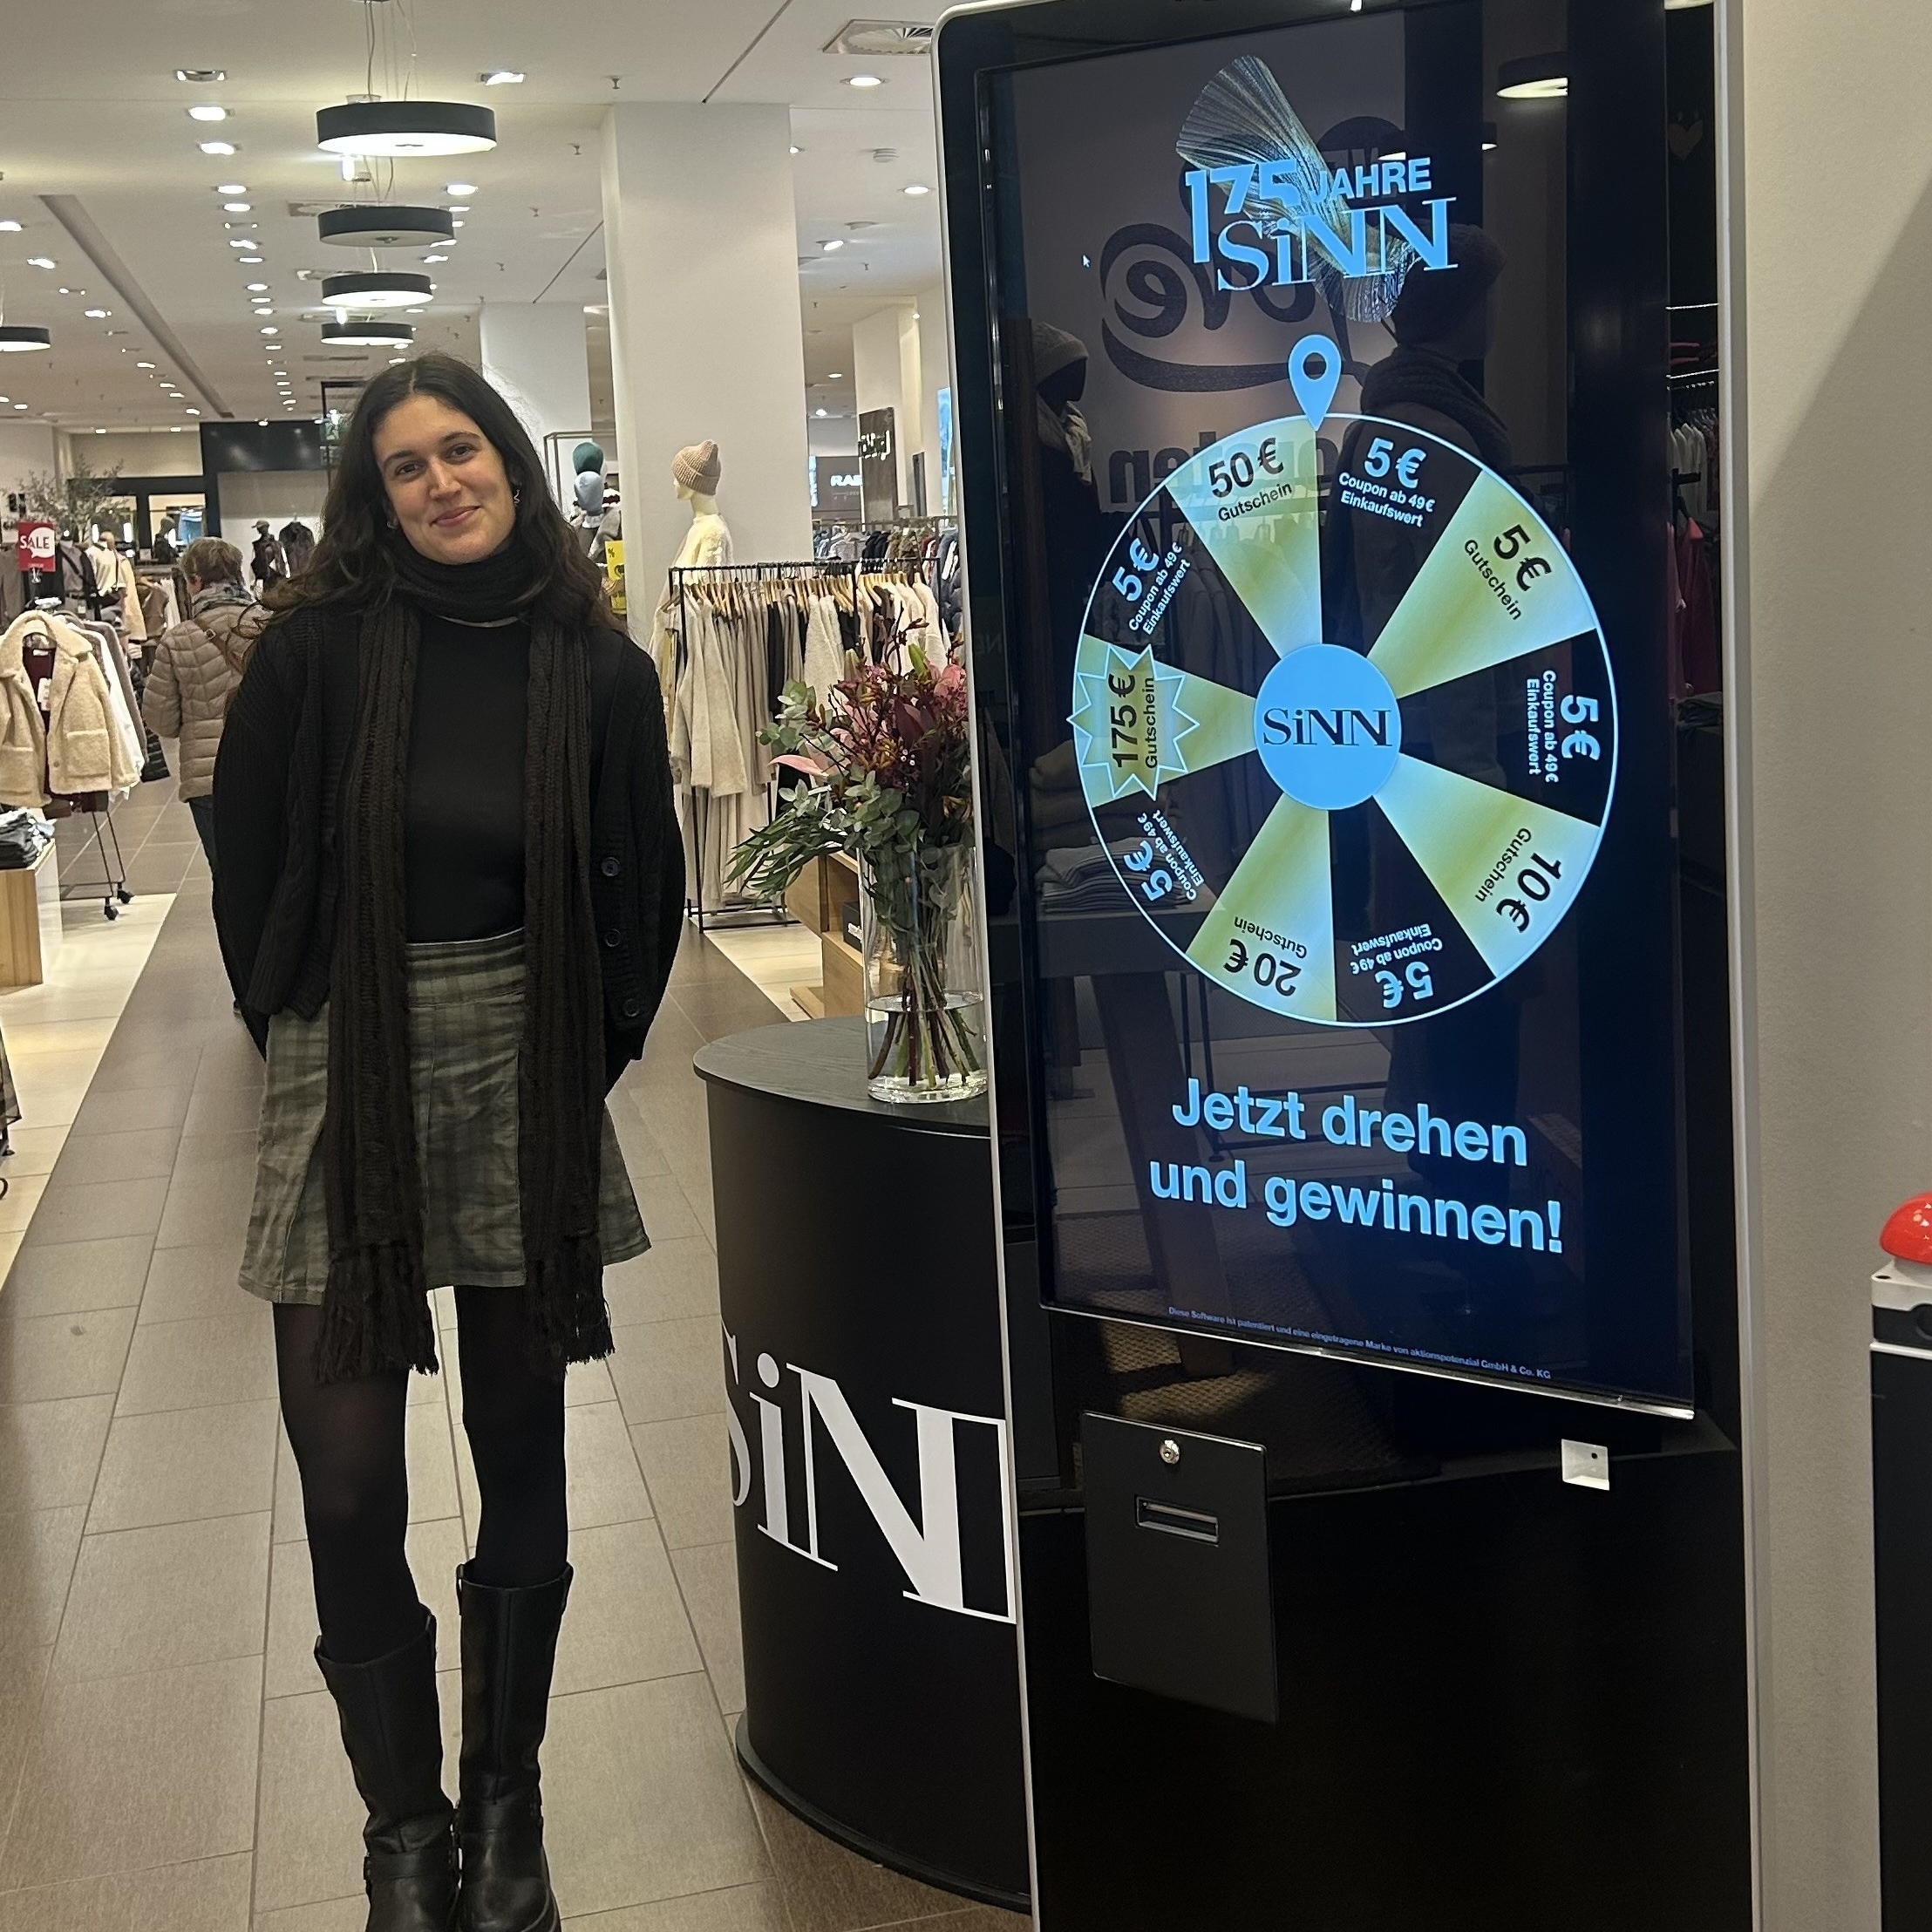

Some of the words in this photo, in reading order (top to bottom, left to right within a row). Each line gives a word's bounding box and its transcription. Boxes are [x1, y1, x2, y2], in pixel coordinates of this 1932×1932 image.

[1185, 158, 1302, 263] 175
[1309, 156, 1432, 203] JAHRE
[1218, 481, 1292, 521] Gutschein
[1338, 472, 1388, 500] Coupon
[1389, 488, 1406, 503] ab
[1408, 494, 1436, 513] 49€
[1340, 490, 1423, 527] Einkaufswert
[20, 534, 51, 550] SALE
[1128, 584, 1159, 631] Coupon
[1155, 569, 1168, 587] ab
[1142, 558, 1191, 636] Einkaufswert
[1464, 539, 1522, 621] Gutschein
[1145, 676, 1159, 769] Gutschein
[1542, 670, 1556, 730] Coupon
[1262, 708, 1393, 747] SiNN
[1527, 678, 1541, 775] Einkaufswert
[1544, 731, 1558, 751] ab
[1152, 809, 1204, 887] Einkaufswert
[1154, 836, 1169, 856] ab
[1473, 827, 1533, 903] Gutschein
[1165, 856, 1197, 901] Coupon
[1234, 915, 1308, 959] Gutschein
[1351, 923, 1432, 956] Einkaufswert
[1376, 949, 1392, 965] ab
[1393, 937, 1443, 958] Coupon
[1172, 1078, 1307, 1140] Jetzt
[1321, 1094, 1528, 1167] drehen
[1149, 1159, 1248, 1209] und
[1264, 1174, 1563, 1254] gewinnen!
[1191, 1310, 1225, 1324] Software
[1276, 1326, 1291, 1336] und
[1292, 1329, 1310, 1338] eine
[1365, 1339, 1391, 1352] Marke
[1393, 1345, 1409, 1356] von
[1480, 1360, 1509, 1372] GmbH
[1510, 1364, 1517, 1373] &
[1519, 1365, 1534, 1377] Co.
[1536, 1369, 1551, 1379] KG
